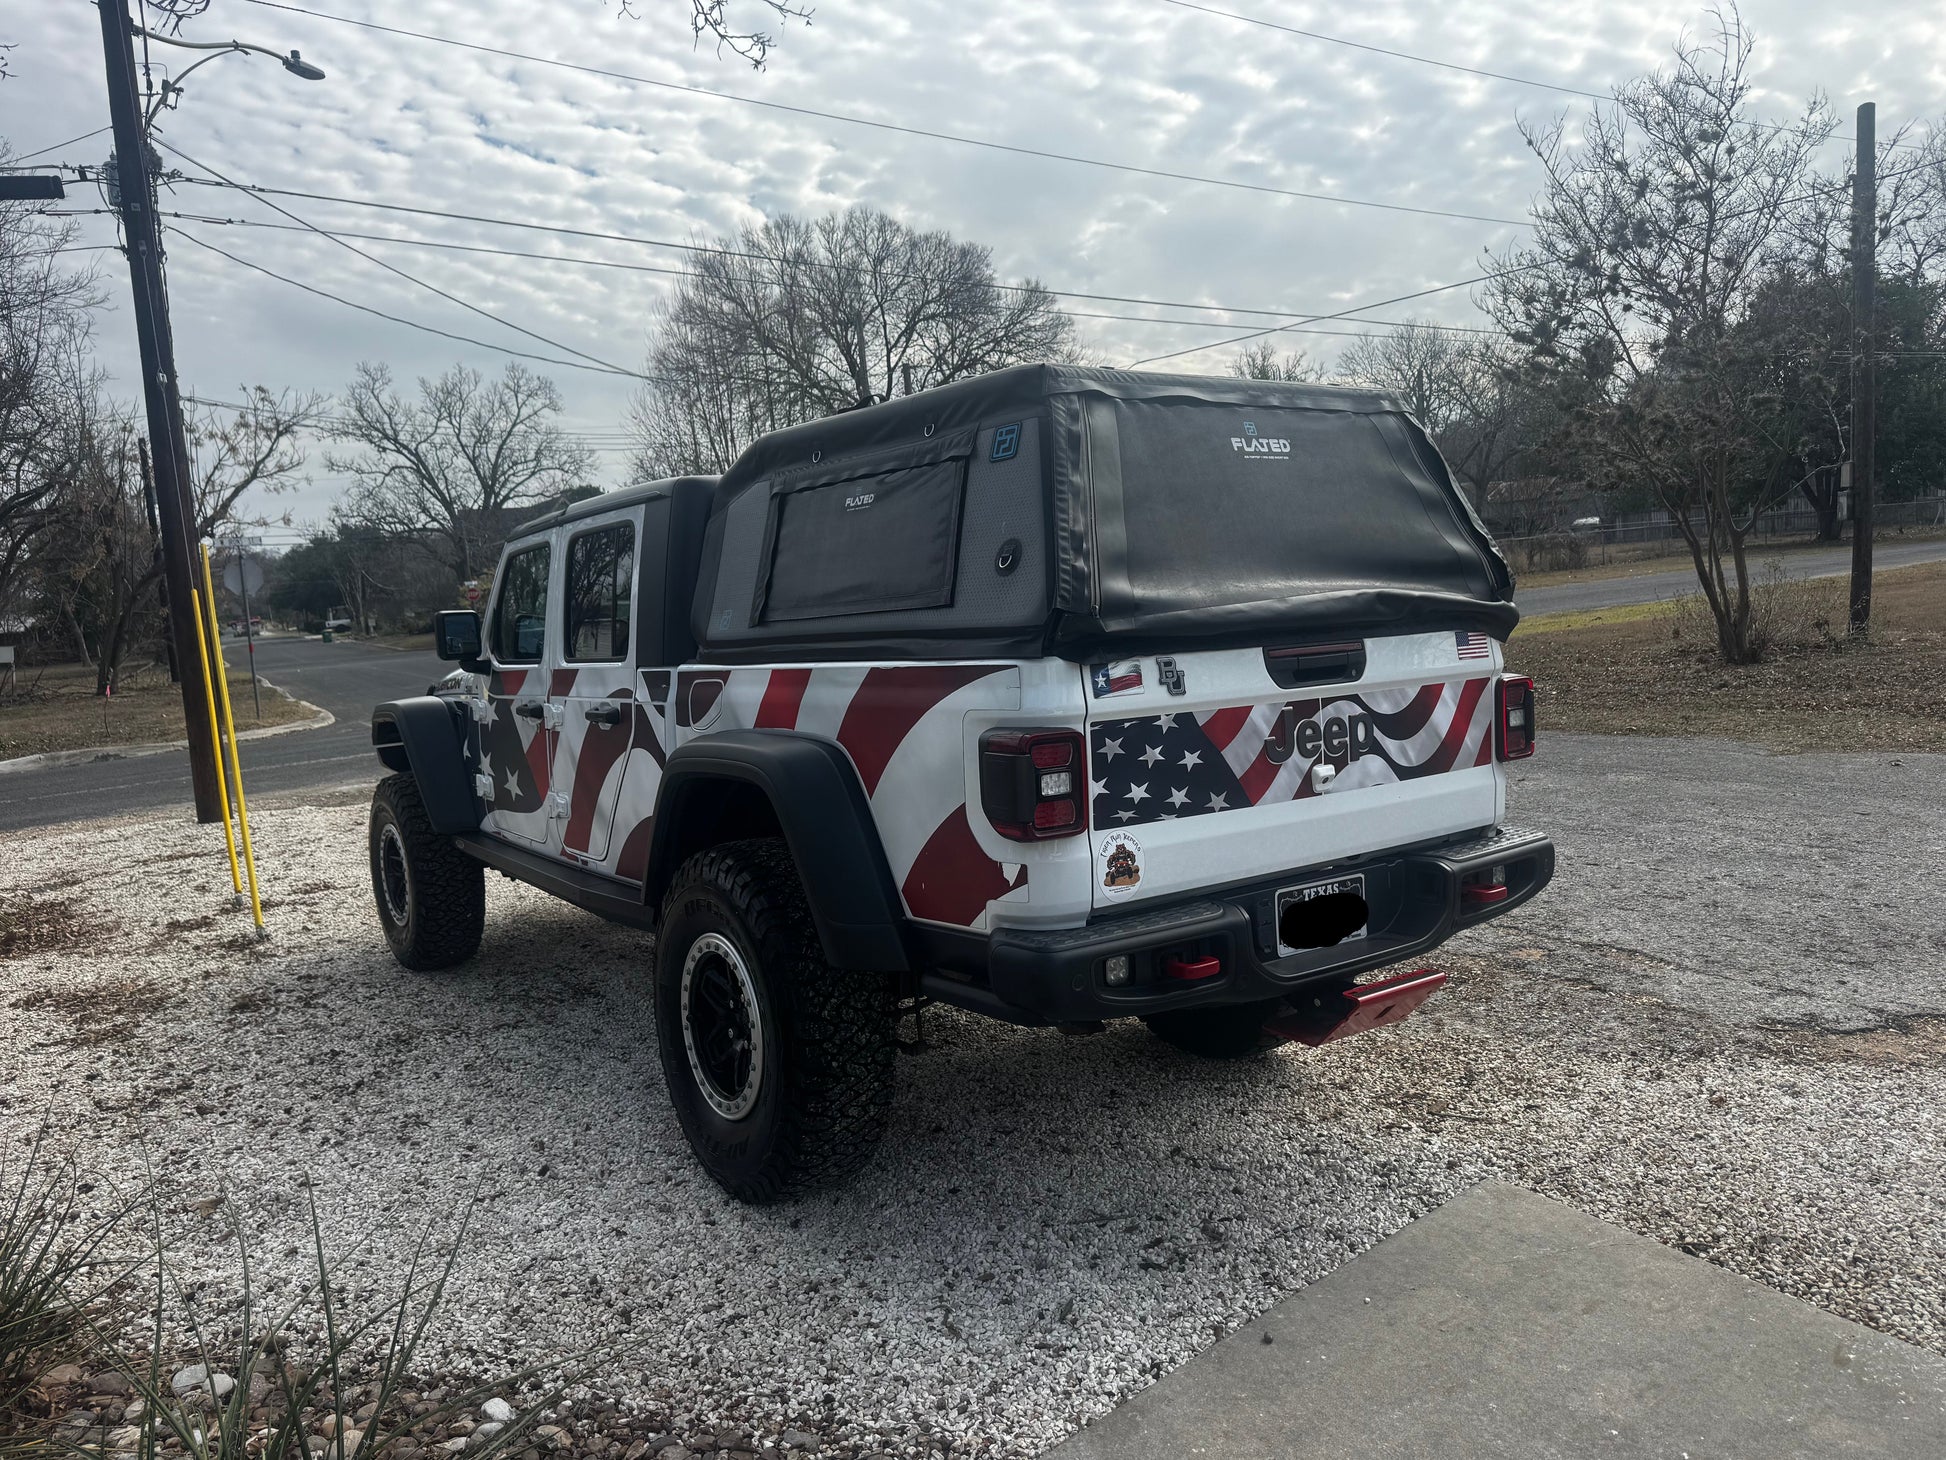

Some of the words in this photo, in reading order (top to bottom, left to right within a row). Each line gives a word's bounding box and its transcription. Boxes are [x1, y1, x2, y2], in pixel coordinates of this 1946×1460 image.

[1230, 437, 1291, 453] FLATED
[845, 493, 875, 507] FLATED
[1263, 706, 1376, 766] Jeep
[1303, 883, 1340, 902] TEXAS
